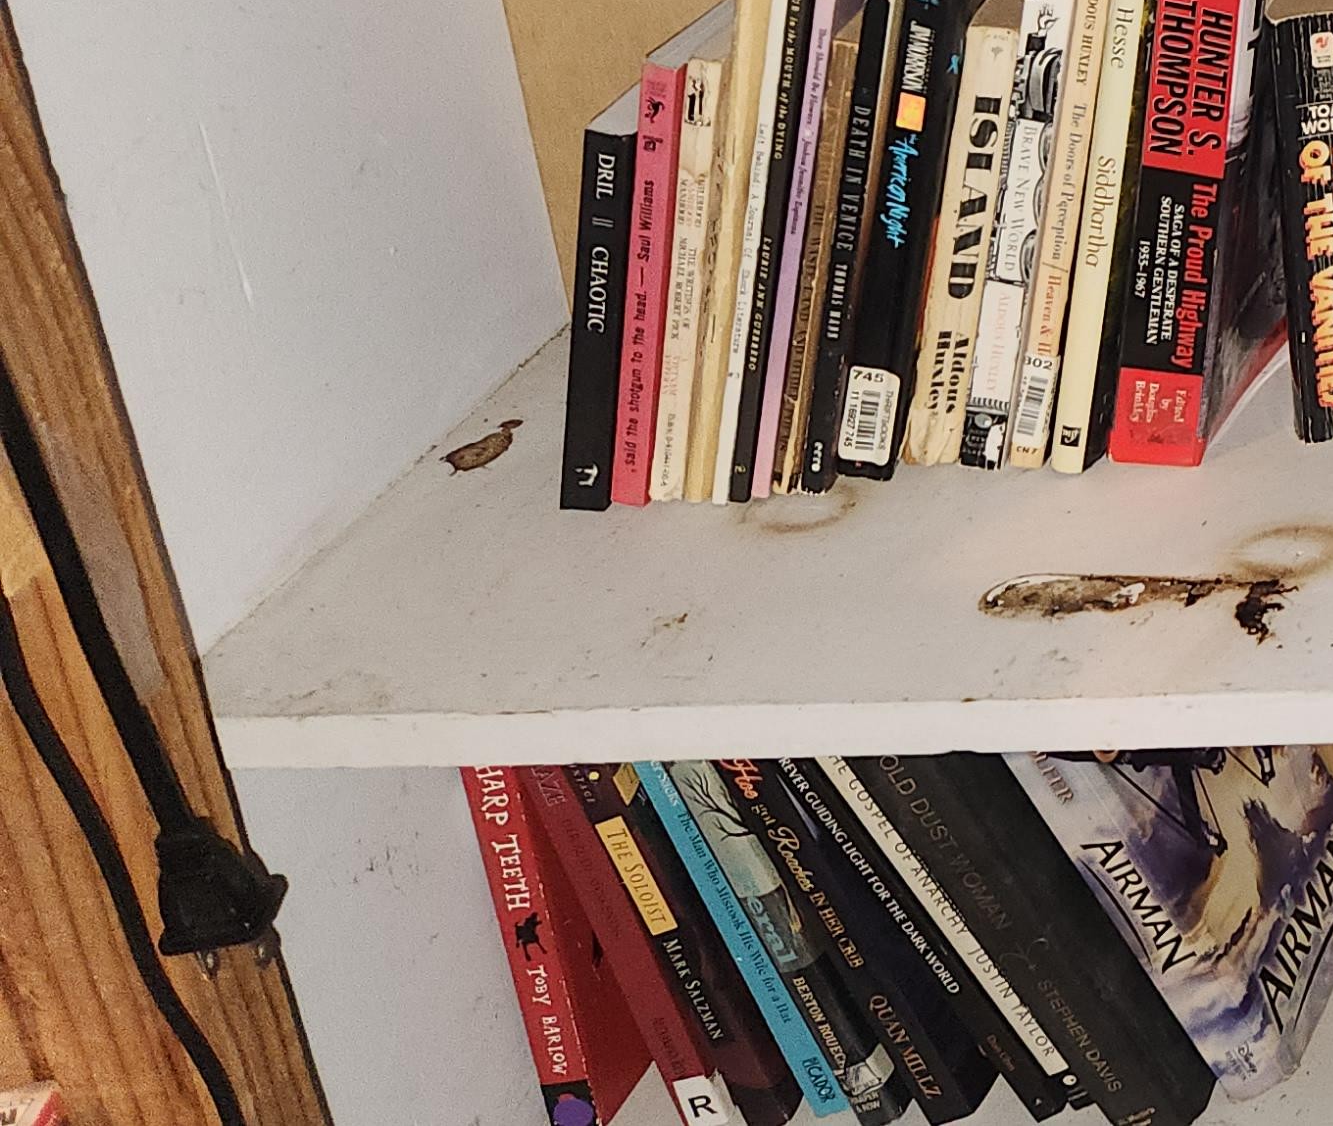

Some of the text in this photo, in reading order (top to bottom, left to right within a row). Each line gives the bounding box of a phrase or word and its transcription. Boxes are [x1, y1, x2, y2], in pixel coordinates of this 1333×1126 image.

[1149, 0, 1198, 156] THOMPSON
[1188, 8, 1234, 157] HUNTER S.
[587, 153, 615, 334] DRIL CHAOTIC
[1170, 182, 1217, 369] The Proud Highway
[852, 370, 883, 383] 745
[492, 834, 530, 909] TEETH
[605, 829, 667, 925] THE SOLOIST
[847, 778, 970, 936] GOSPEL OF ANARCHY
[1079, 839, 1197, 975] AIRMAN
[526, 965, 566, 1076] TOBY BARLOW
[661, 938, 724, 1041] MARK SALZMAN
[968, 945, 1056, 1057] JUSTIN TAYLOR
